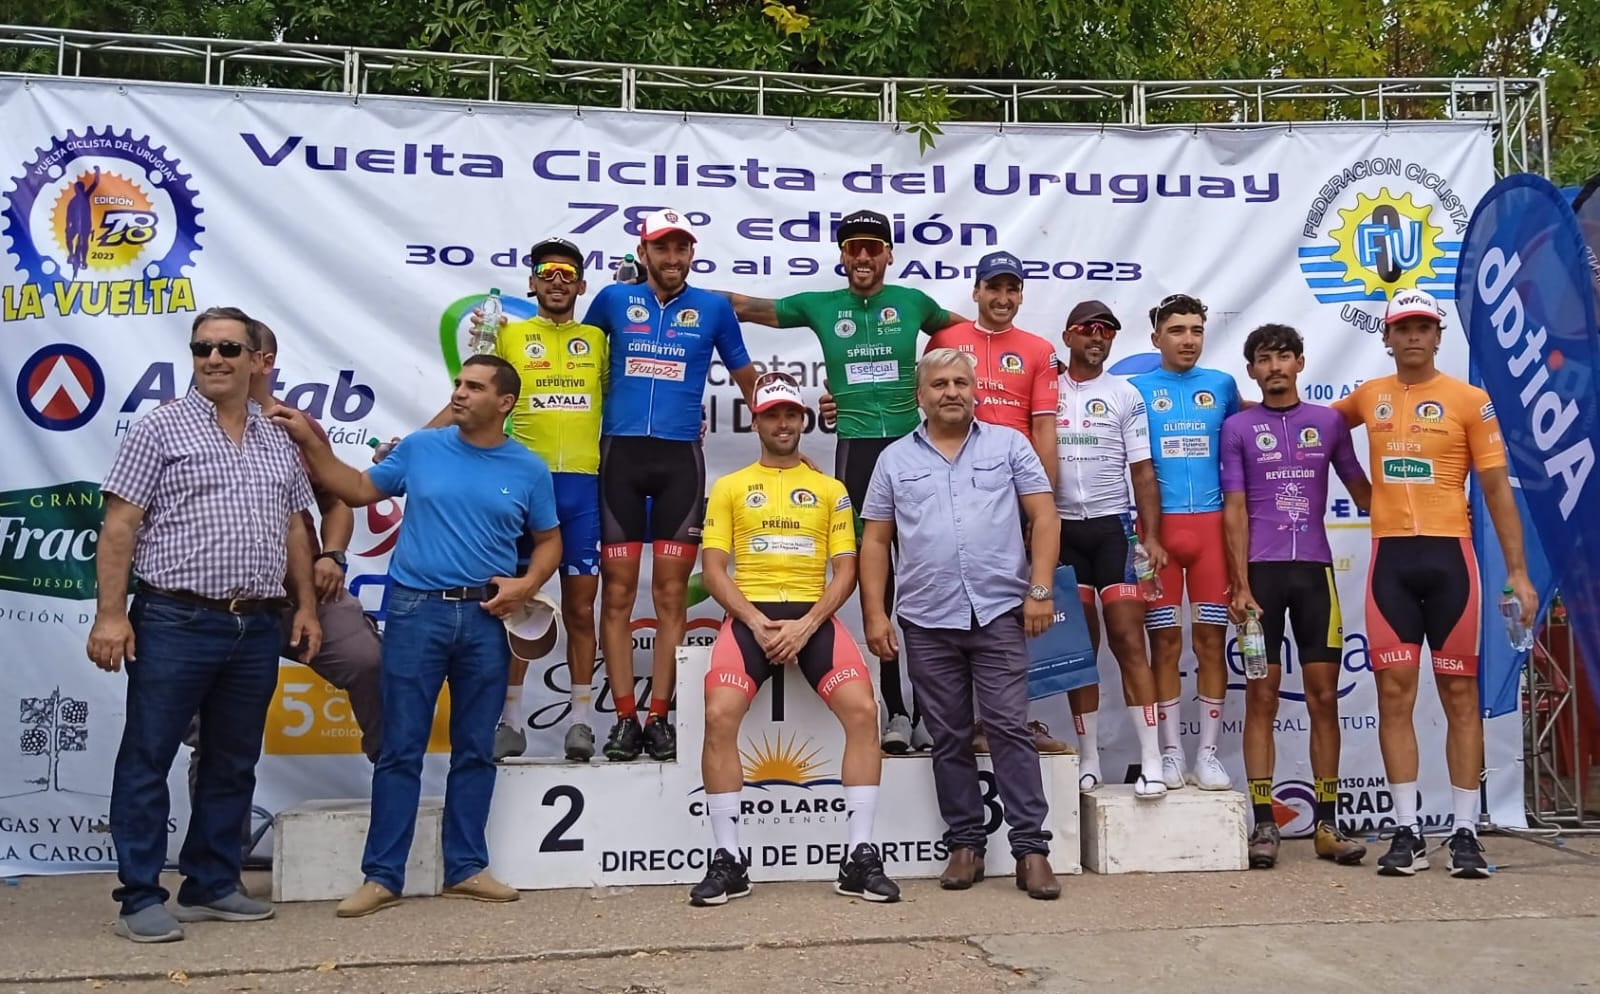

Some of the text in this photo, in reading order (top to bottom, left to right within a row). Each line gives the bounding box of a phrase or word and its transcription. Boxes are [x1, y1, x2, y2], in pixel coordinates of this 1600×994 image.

[34, 138, 178, 183] VUELTA CICLISTA DEL URUGUAY
[240, 132, 1280, 204] Vuelta Ciclista del Uruguay
[1303, 157, 1471, 239] FEDERACION CICLISTA
[737, 210, 998, 247] ediión
[91, 251, 115, 261] 2023
[405, 244, 474, 267] 30
[732, 256, 771, 276] al
[787, 257, 820, 276] 9
[1022, 260, 1142, 282] 2023
[3, 277, 197, 321] LA VUELTA
[547, 395, 587, 405] AYALA
[1305, 384, 1333, 400] 100
[762, 520, 800, 529] PREMIO
[32, 577, 84, 590] DESDE
[1379, 649, 1412, 664] VILLA
[719, 667, 859, 696] VILLA TERESA
[281, 683, 315, 737] 5
[1366, 776, 1386, 788] AM
[48, 818, 61, 834] Y
[538, 785, 585, 852] 2
[762, 844, 798, 867] DE
